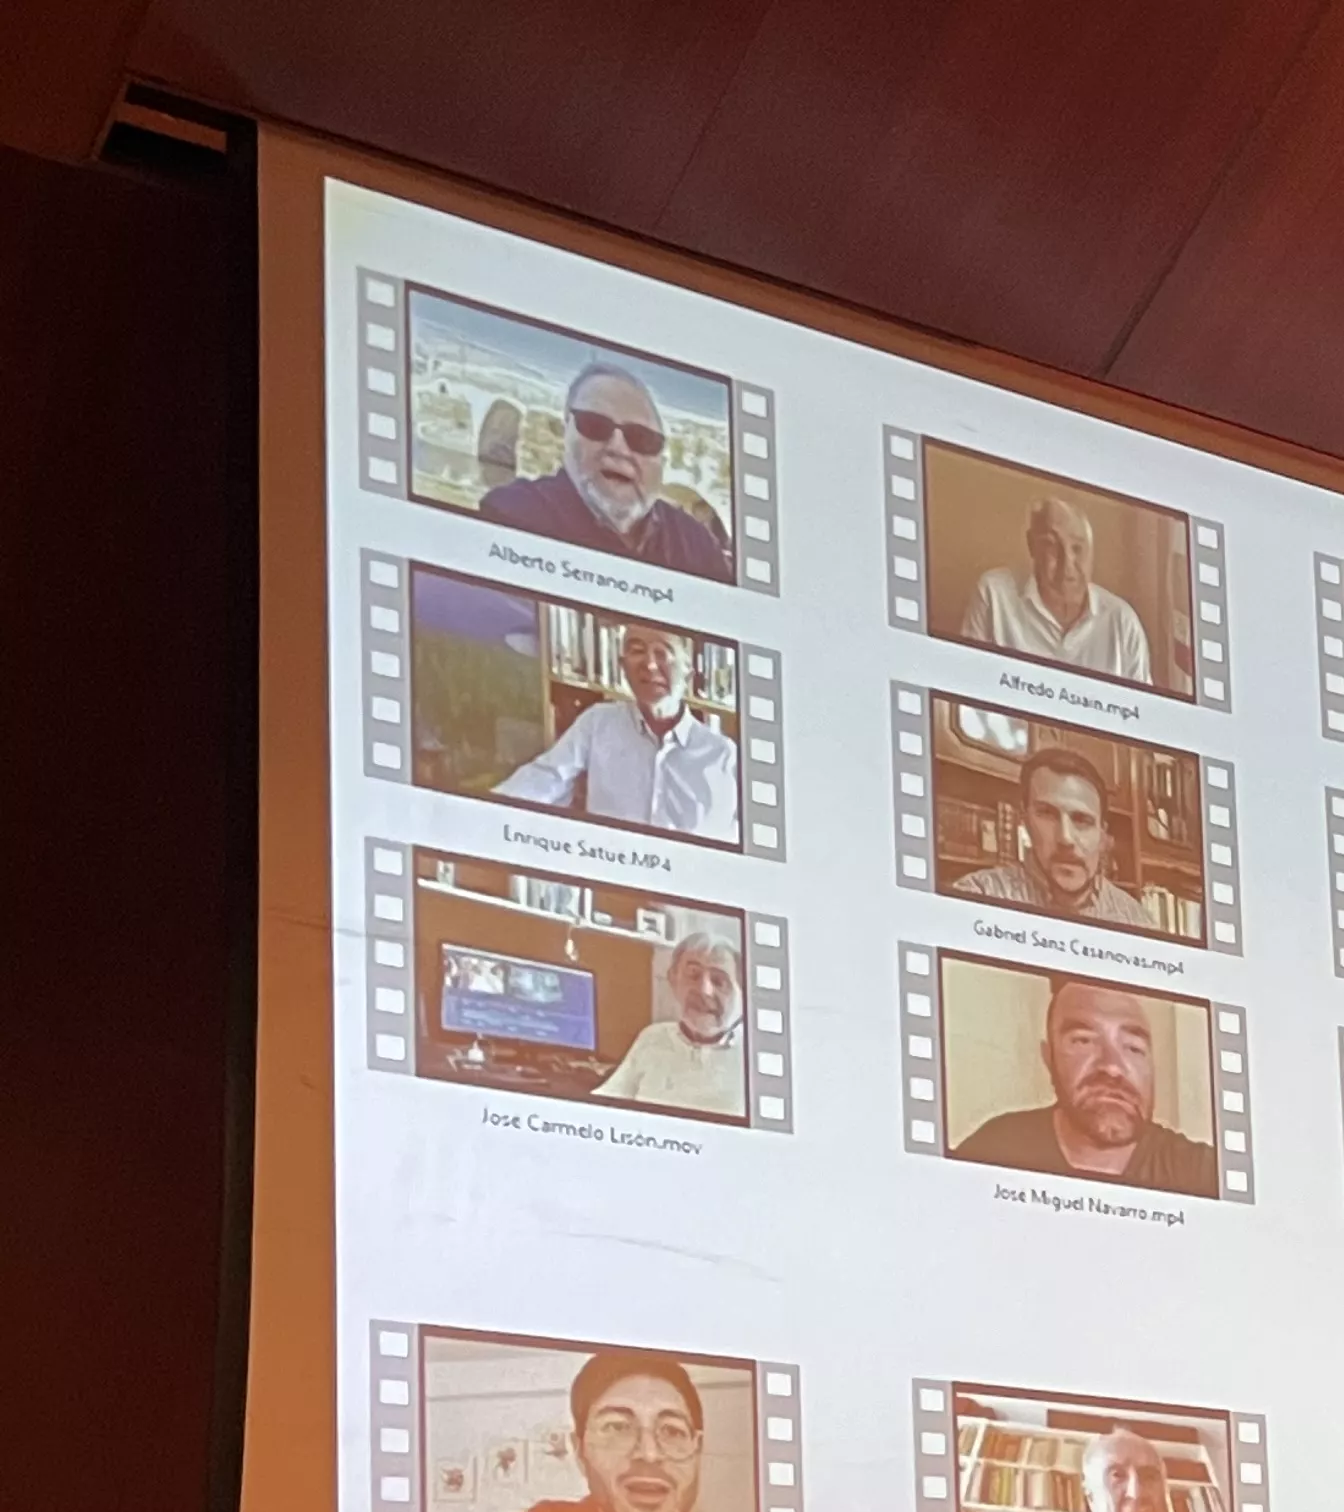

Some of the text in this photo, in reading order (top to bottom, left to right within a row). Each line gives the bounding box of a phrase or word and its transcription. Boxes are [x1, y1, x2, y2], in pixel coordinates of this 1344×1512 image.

[488, 542, 674, 603] Alberto Serrano.mp4
[999, 672, 1054, 700] Alfredo
[503, 824, 572, 854] Enrique
[973, 919, 1184, 976] Gabriel Sanz Casanovas.mp4
[527, 1114, 604, 1141] Carmelo
[1031, 1189, 1084, 1212] Miguel
